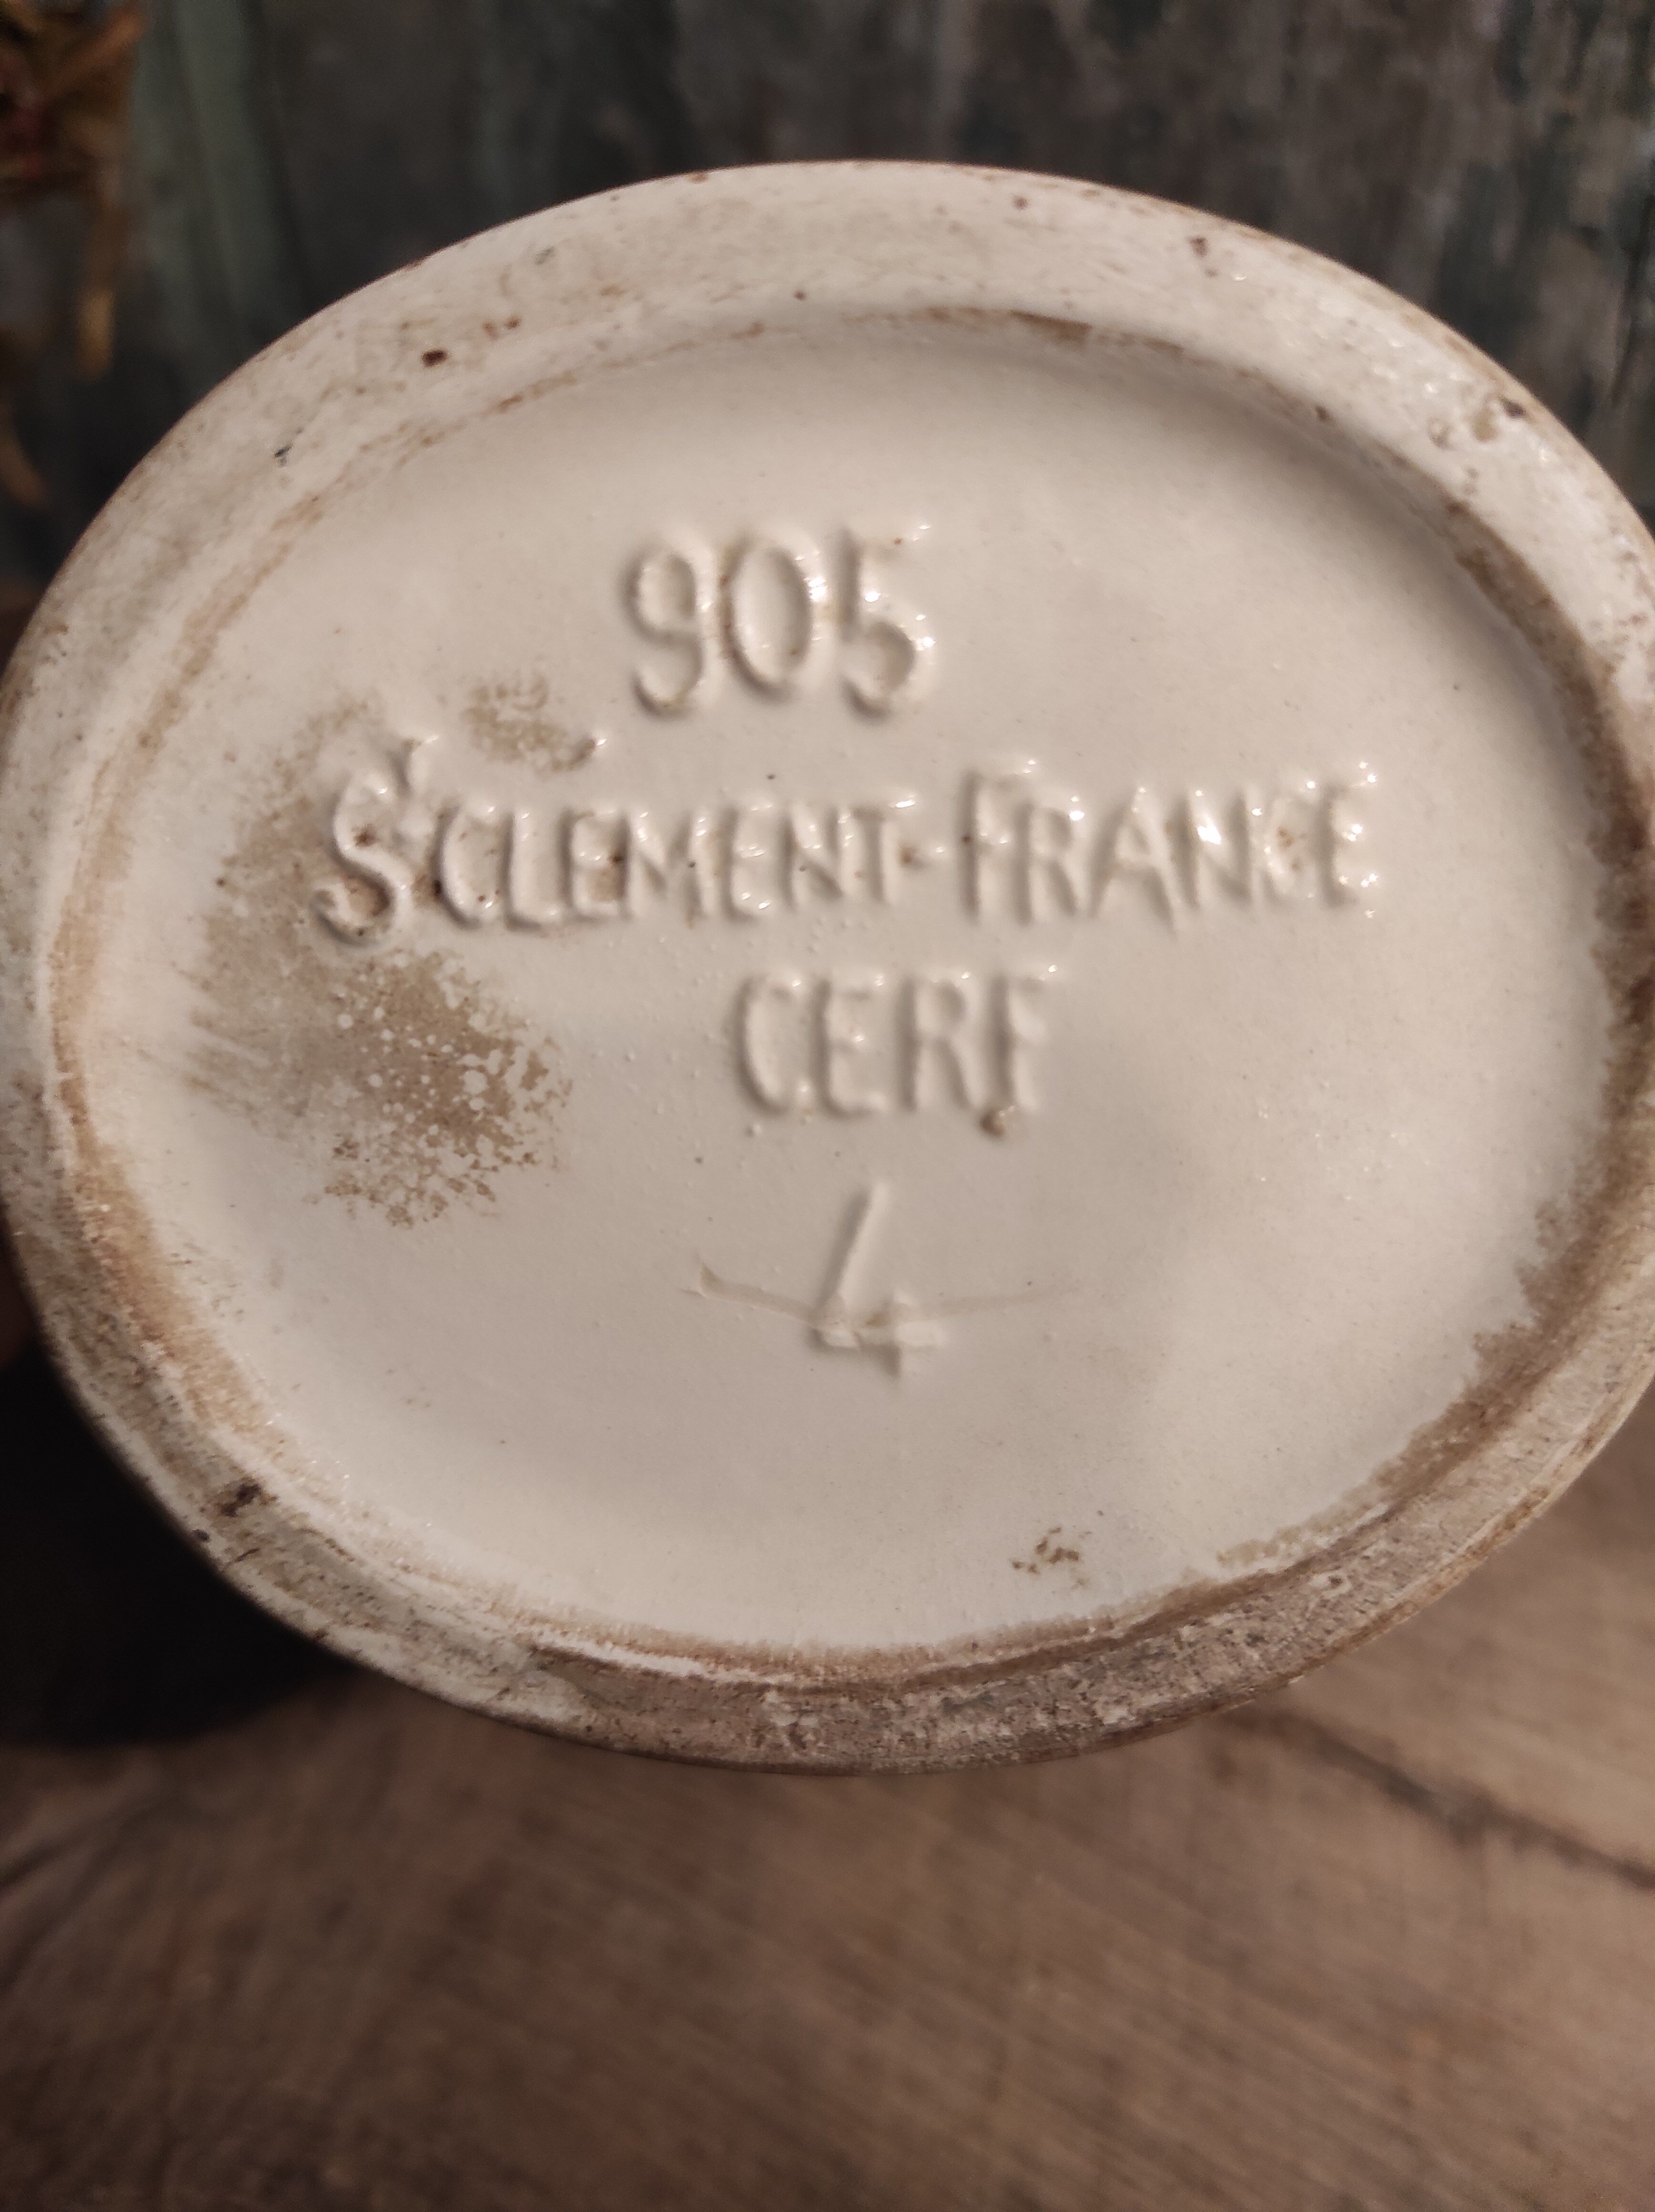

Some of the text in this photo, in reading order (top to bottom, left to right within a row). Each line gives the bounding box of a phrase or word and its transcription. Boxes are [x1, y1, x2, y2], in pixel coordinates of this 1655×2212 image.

[621, 521, 938, 719] 905
[733, 964, 1059, 1123] CERF
[806, 1180, 946, 1379] 4
